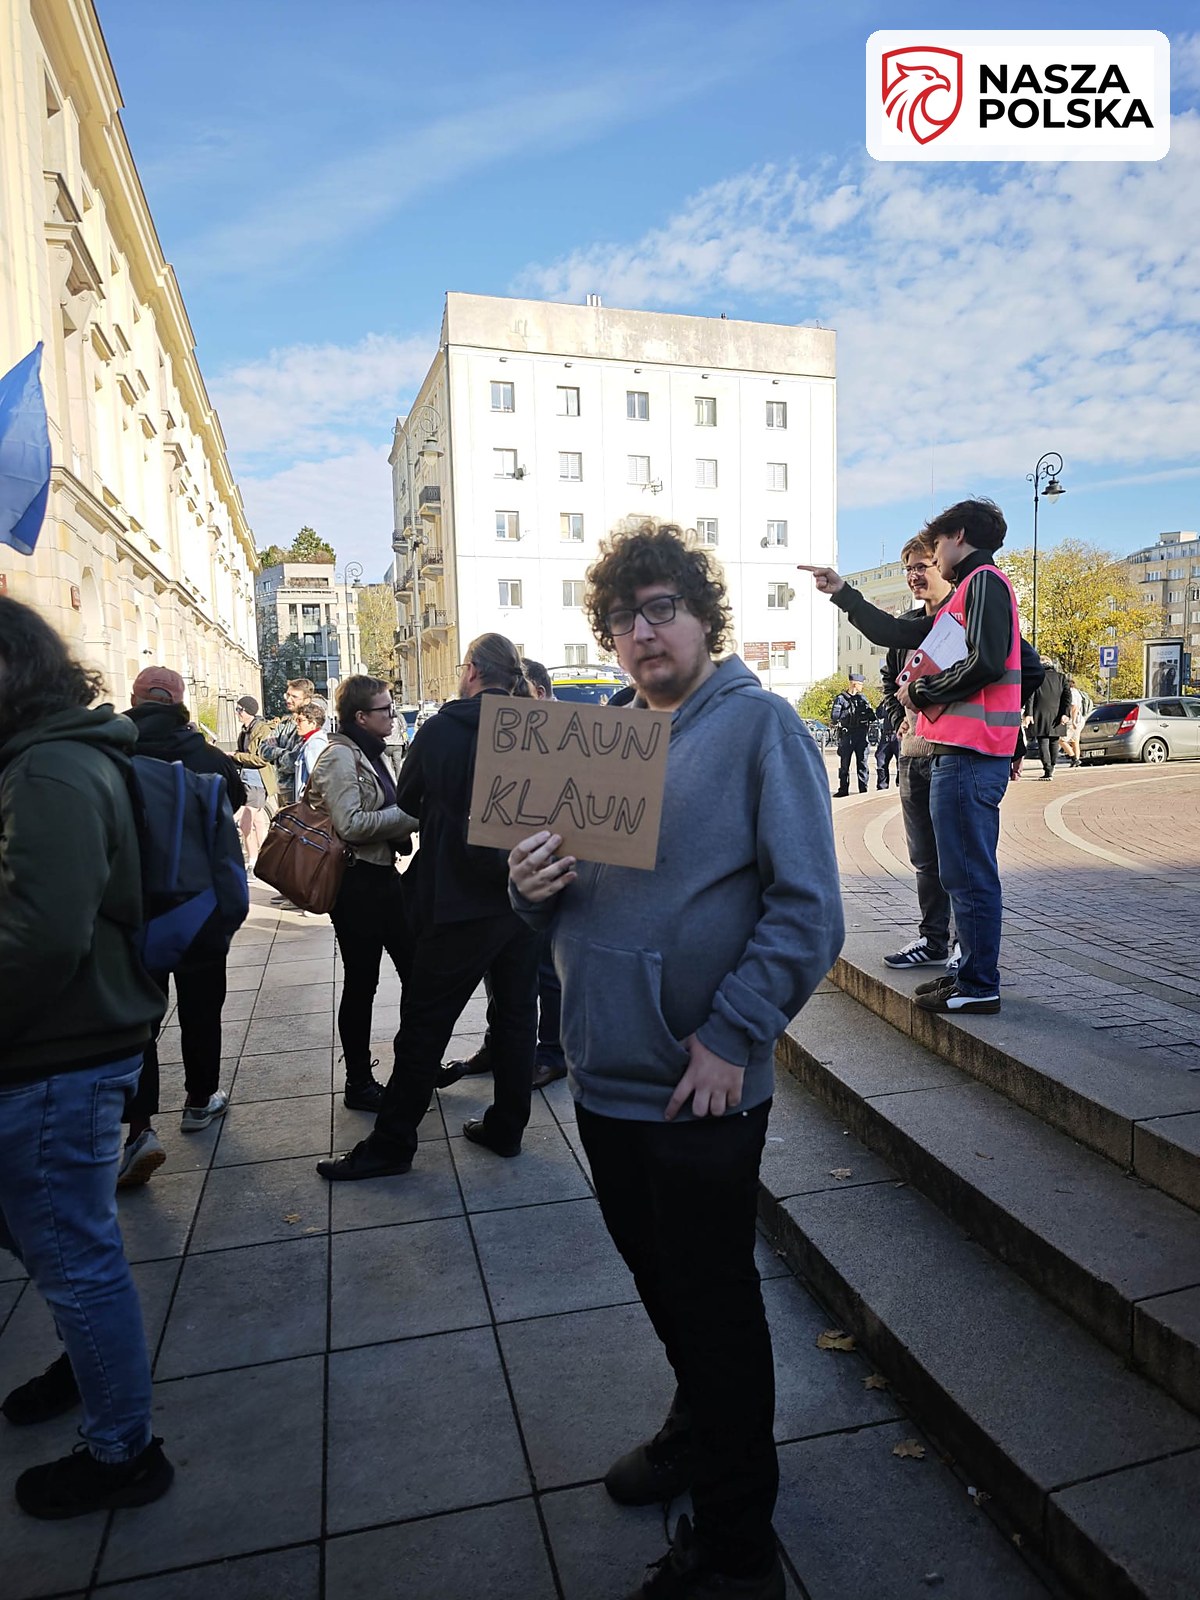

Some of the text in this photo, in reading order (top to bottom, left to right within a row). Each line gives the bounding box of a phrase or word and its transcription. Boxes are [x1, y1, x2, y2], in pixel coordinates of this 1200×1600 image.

[1103, 648, 1115, 666] P
[493, 707, 662, 761] BRAUN
[481, 775, 646, 835] KLAUN
